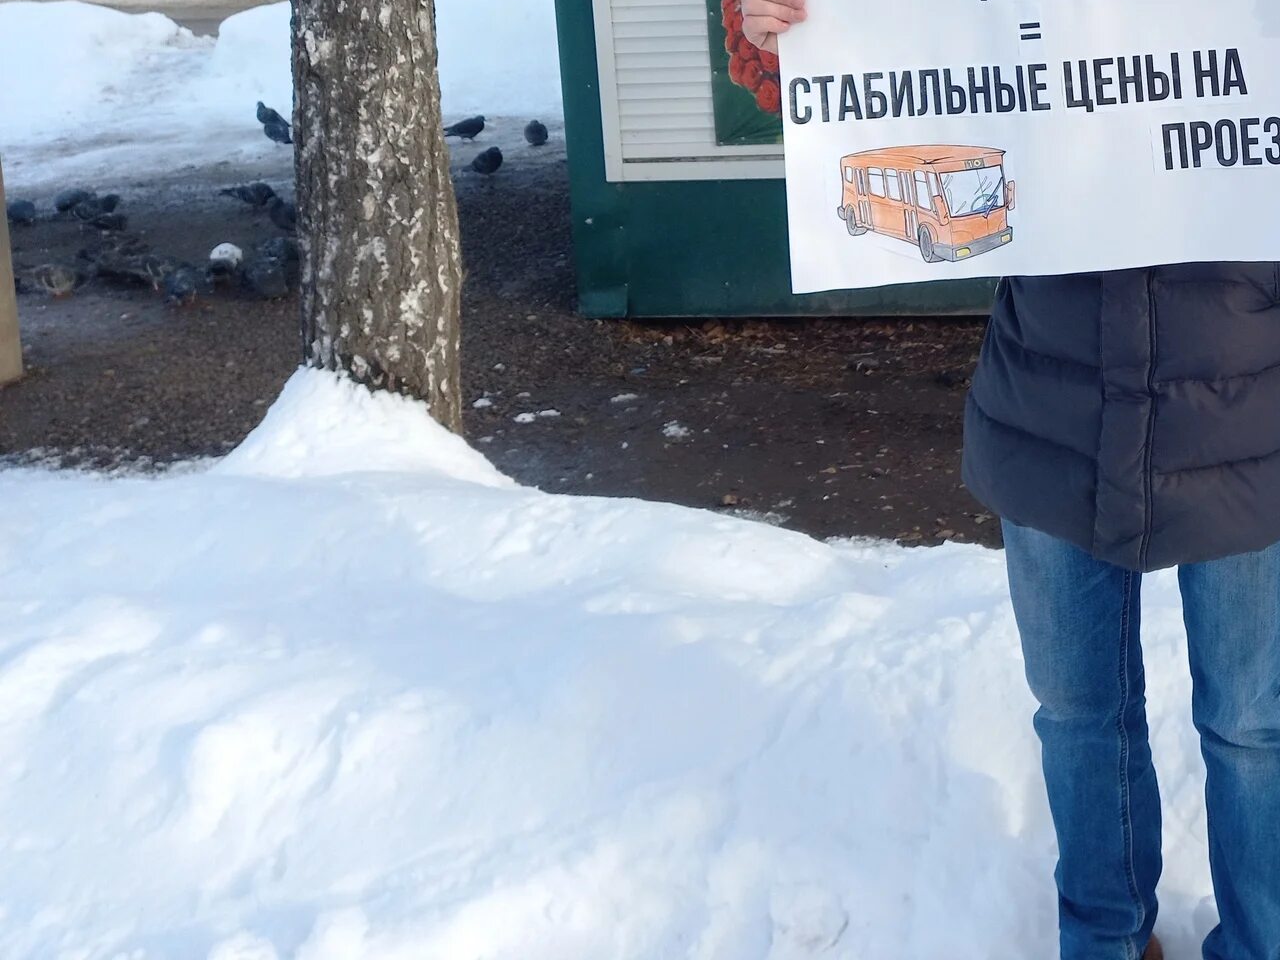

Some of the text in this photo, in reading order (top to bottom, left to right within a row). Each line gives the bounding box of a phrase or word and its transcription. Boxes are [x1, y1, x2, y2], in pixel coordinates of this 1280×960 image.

[789, 48, 1248, 125] СТАБИЛЬНЫЕ ЦЕНЫ НА
